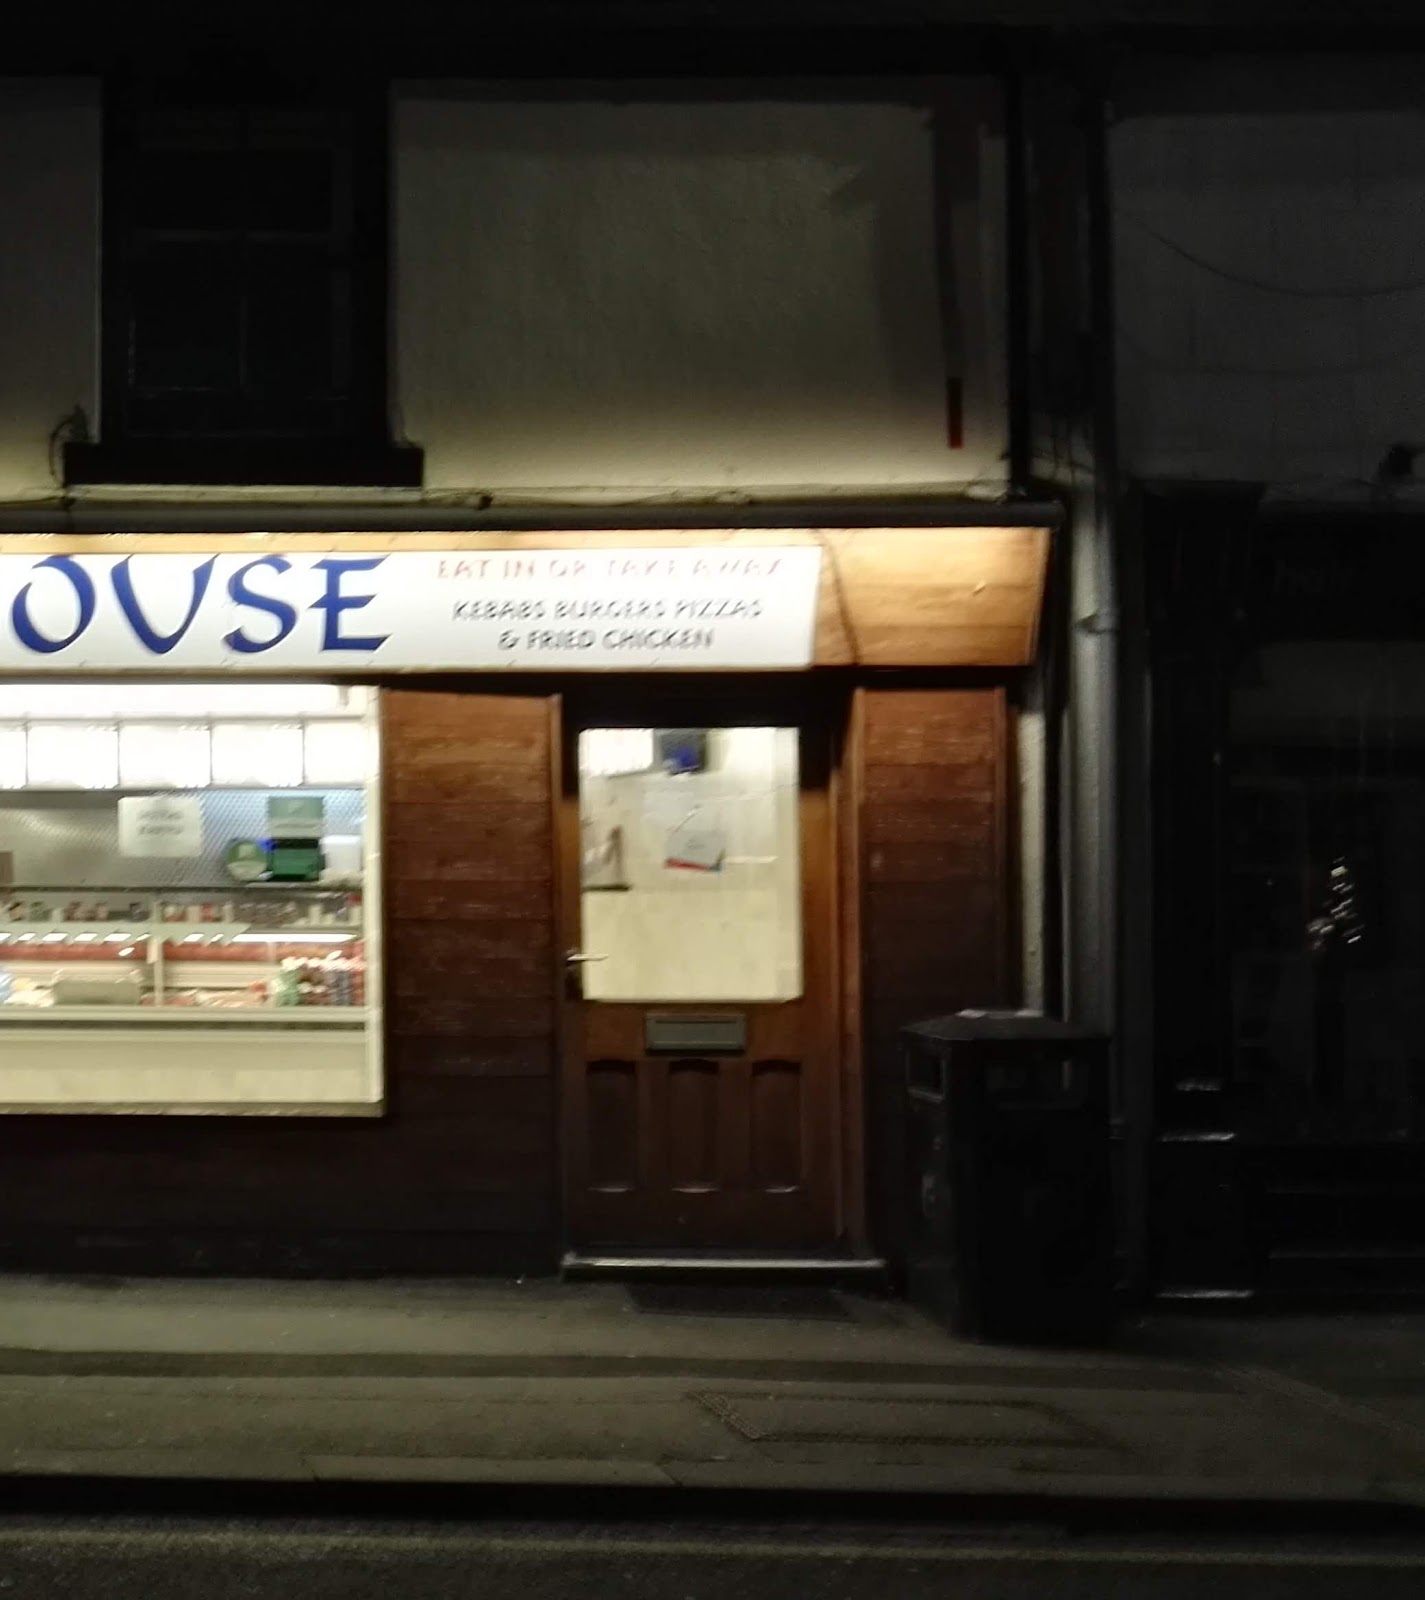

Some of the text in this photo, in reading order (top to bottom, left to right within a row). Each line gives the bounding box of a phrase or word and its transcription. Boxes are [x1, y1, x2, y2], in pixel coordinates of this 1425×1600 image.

[436, 559, 491, 580] EAT
[503, 559, 535, 579] IN
[452, 599, 764, 621] KEBABS BURGERS PIZZAS
[498, 628, 715, 651] & FRIED CHICKEN
